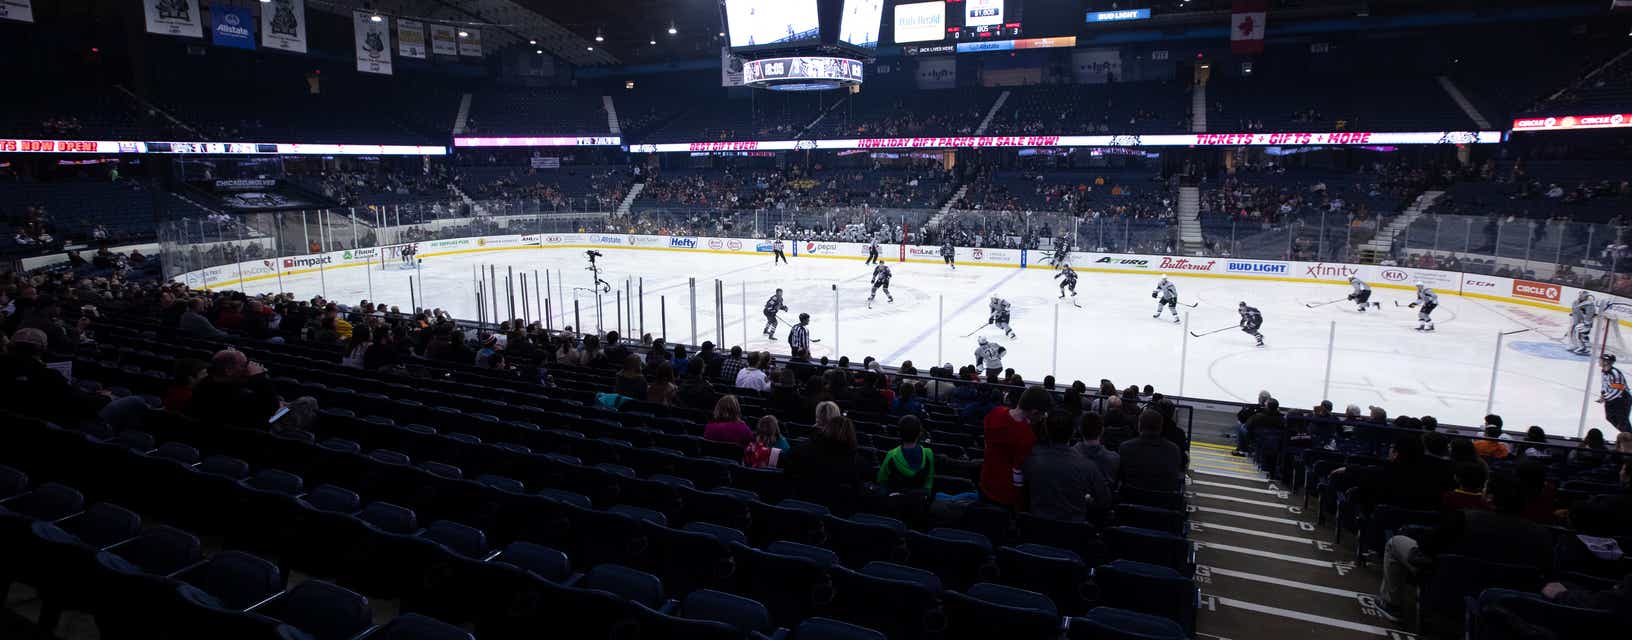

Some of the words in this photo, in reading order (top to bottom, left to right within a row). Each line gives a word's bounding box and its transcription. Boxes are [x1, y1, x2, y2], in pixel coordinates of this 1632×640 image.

[1114, 11, 1138, 19] LIGHT
[216, 24, 248, 35] Allstate
[858, 138, 910, 148] HOWLIDAY
[912, 138, 937, 147] GIFT
[938, 137, 976, 147] PACKS
[978, 137, 993, 146] ON
[996, 136, 1026, 146] SALE
[1027, 136, 1060, 146] NOW!
[1196, 134, 1254, 144] TICKETS
[1268, 133, 1312, 144] GIFTS
[1327, 133, 1371, 143] MORE
[22, 140, 54, 152] NOW
[58, 141, 98, 152] OPEN!
[712, 142, 731, 150] GIFT
[734, 141, 758, 150] EVER!
[671, 238, 696, 248] Hefty
[818, 242, 837, 252] pepsi
[294, 254, 332, 268] impact
[1160, 256, 1216, 271] Butternut
[1229, 262, 1252, 271] BUD
[1253, 264, 1287, 273] LIGHT
[1306, 265, 1358, 279] xfinity
[1385, 271, 1404, 279] KIA
[1516, 285, 1546, 296] CIRCLE
